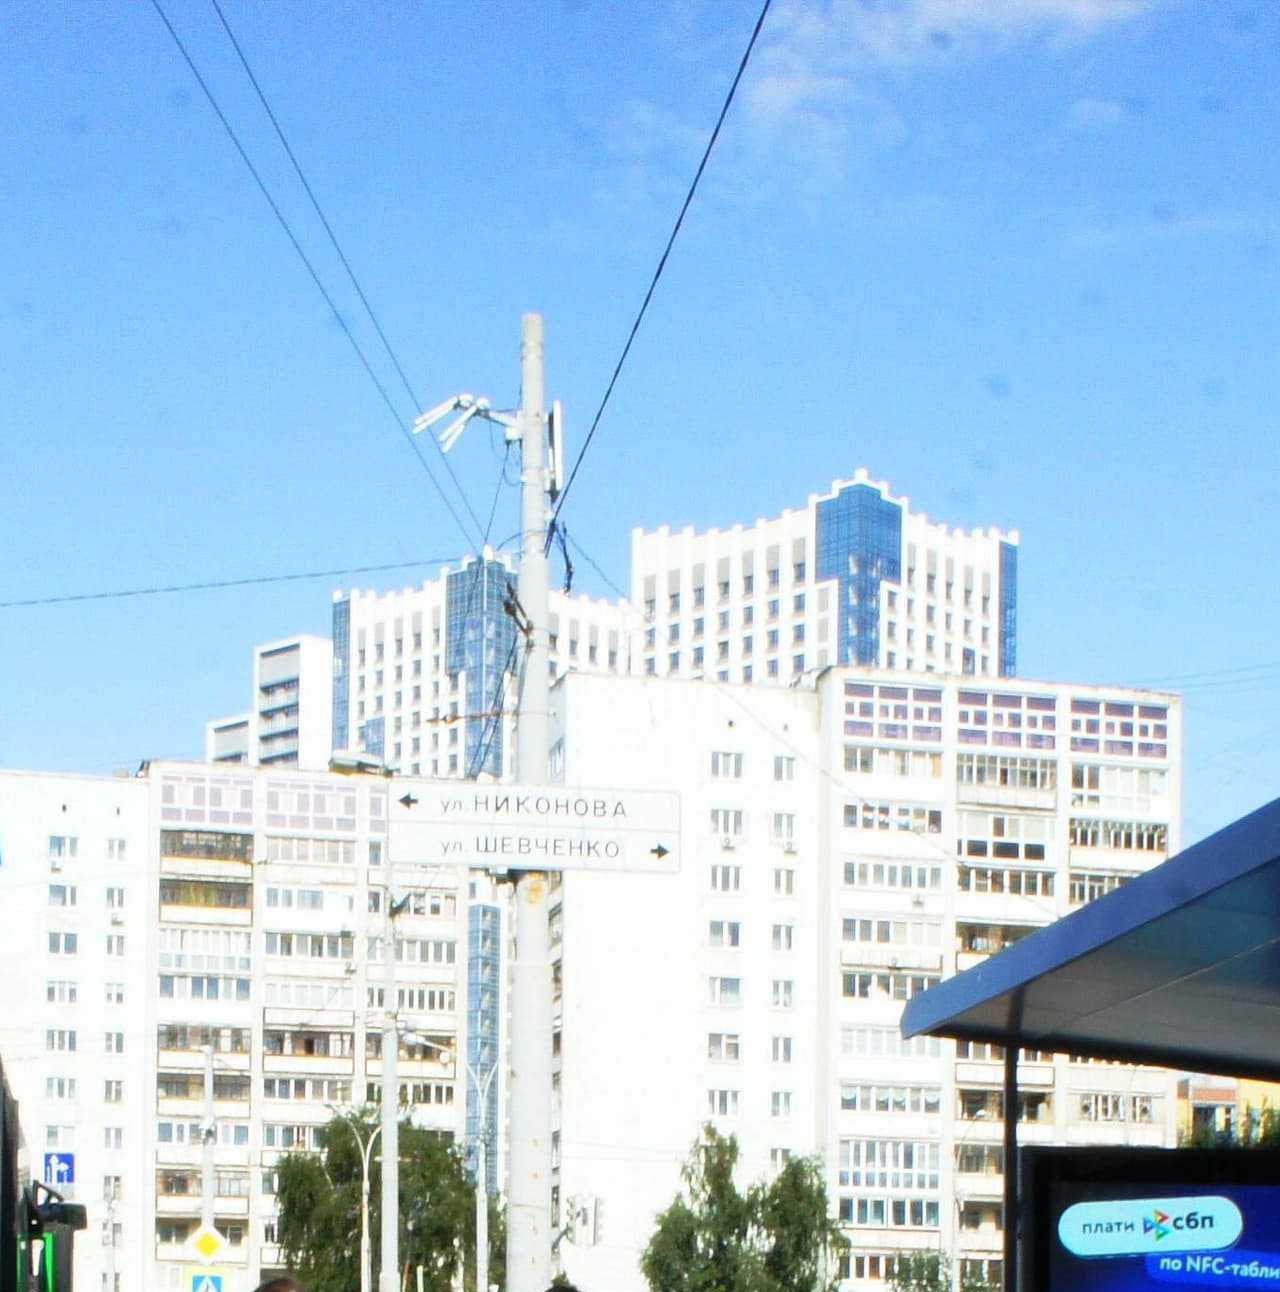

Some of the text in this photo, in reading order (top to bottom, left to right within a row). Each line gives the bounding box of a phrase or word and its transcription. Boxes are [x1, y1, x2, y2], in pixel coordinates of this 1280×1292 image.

[473, 794, 627, 817] НИКОНОВА
[476, 836, 620, 858] ШЕВЧЕНКО
[1082, 1212, 1214, 1235] плати сбп
[1160, 1257, 1183, 1270] по
